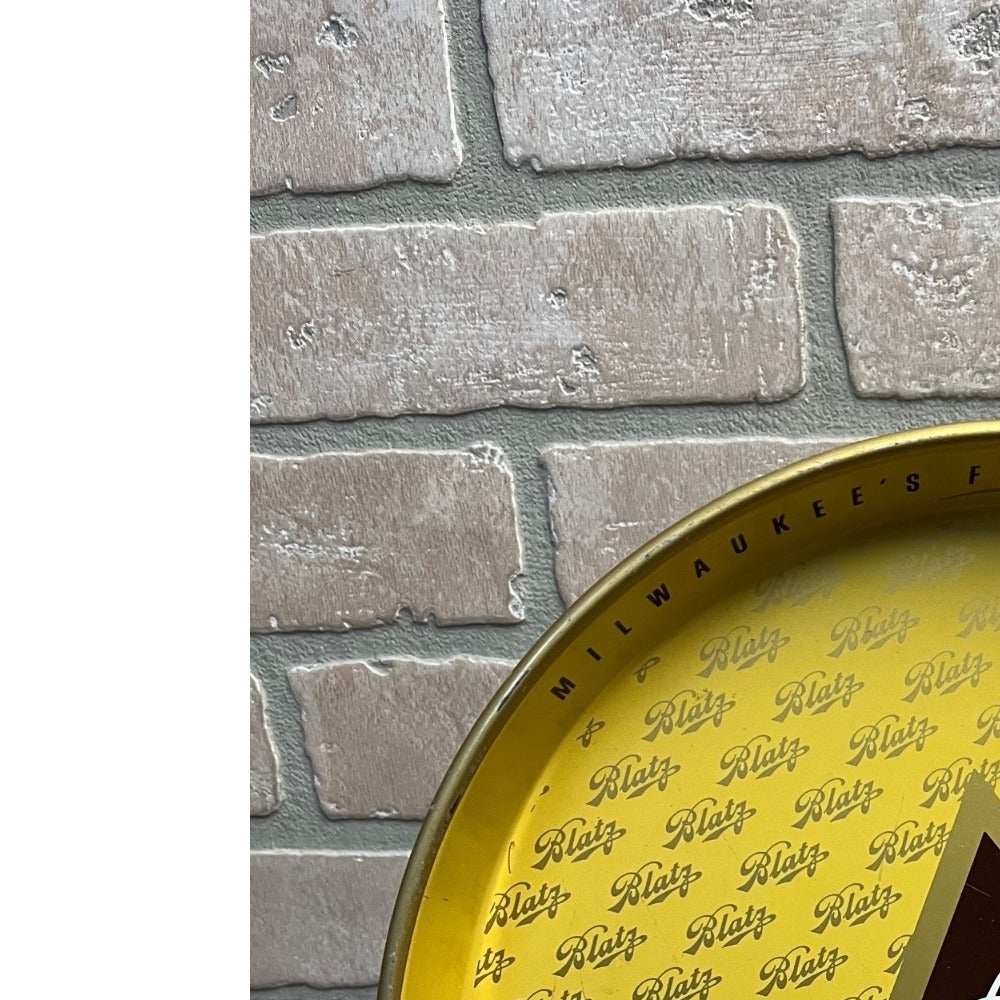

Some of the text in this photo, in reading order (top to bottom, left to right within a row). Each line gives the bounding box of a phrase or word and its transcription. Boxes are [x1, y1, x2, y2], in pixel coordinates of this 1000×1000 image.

[550, 472, 920, 701] MILWAUKEE'S
[697, 625, 791, 677] Blatz
[827, 606, 920, 658] Blatz
[772, 673, 864, 723] Blatz
[902, 651, 993, 703] Blatz
[642, 690, 736, 742] Blatz
[846, 715, 938, 767] Blatz
[586, 754, 681, 807] Blatz
[716, 735, 810, 787] Blatz
[662, 797, 757, 850] Blatz
[791, 778, 884, 829] Blatz
[531, 818, 627, 871] Blatz
[737, 841, 830, 893] Blatz
[865, 820, 950, 871] Blatz
[607, 861, 702, 914] Blatz
[811, 883, 902, 935] Blatz
[553, 924, 648, 978] Blatz
[682, 904, 777, 956] Blatz
[756, 945, 849, 997] Blatz
